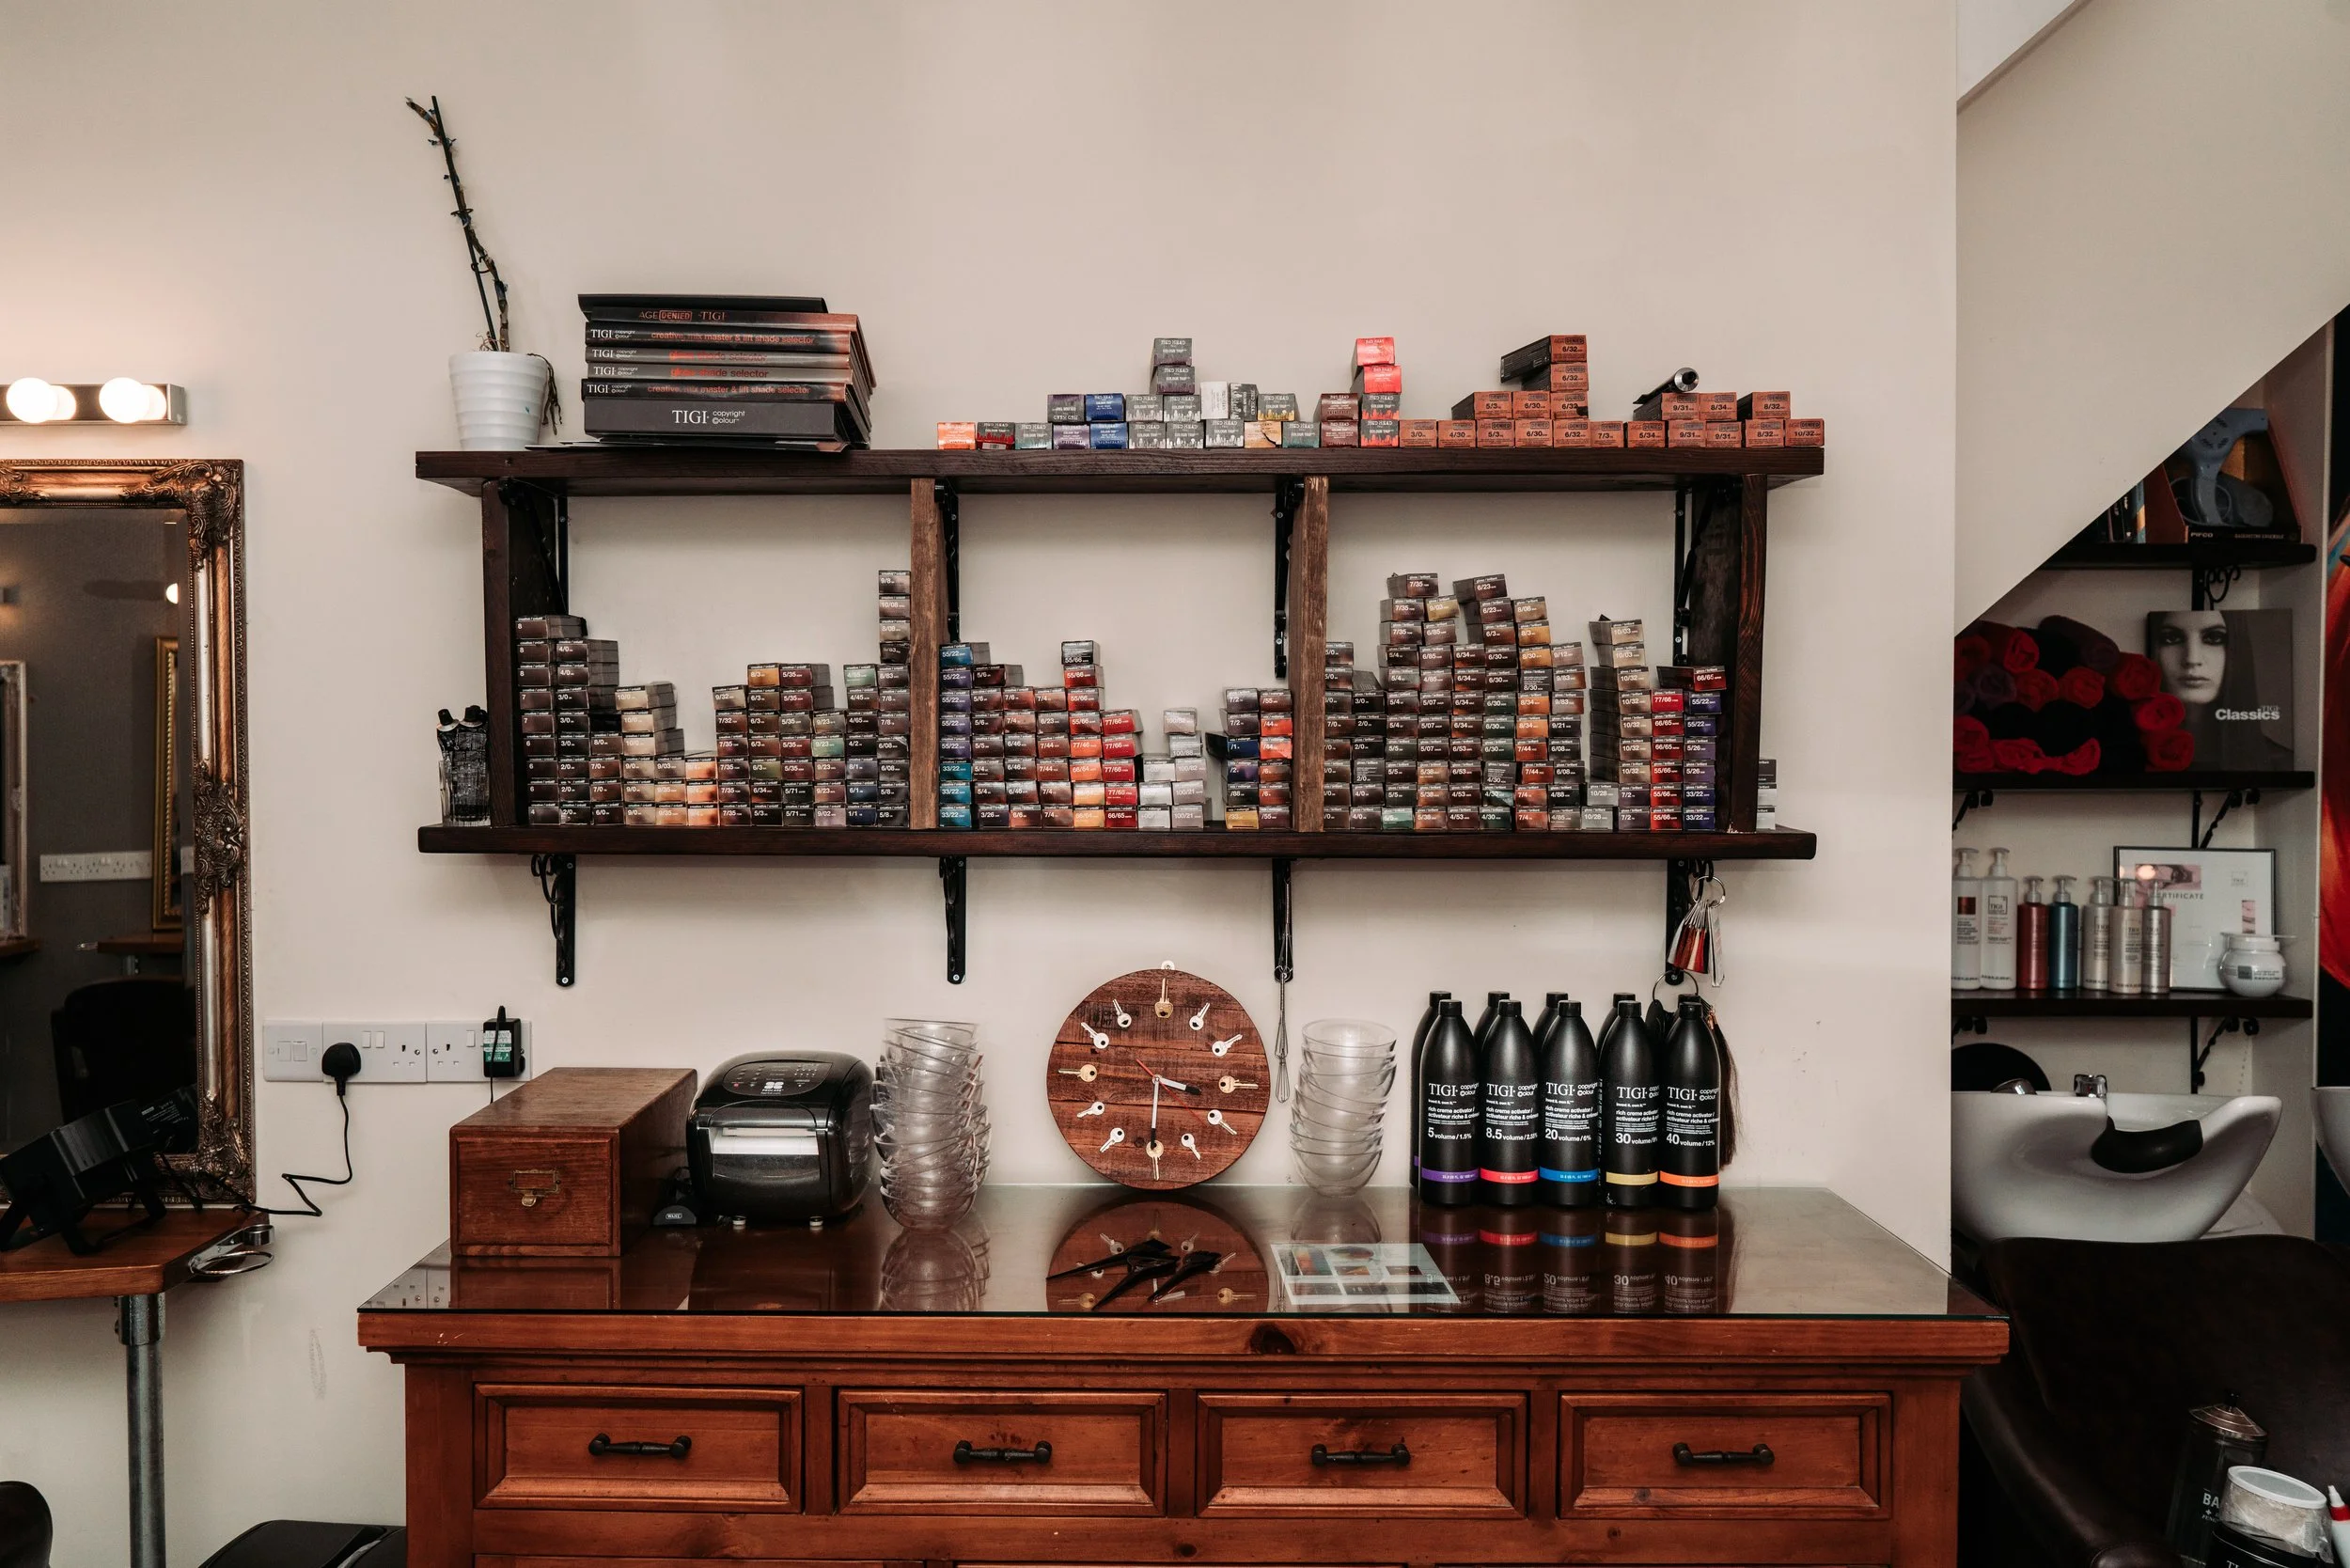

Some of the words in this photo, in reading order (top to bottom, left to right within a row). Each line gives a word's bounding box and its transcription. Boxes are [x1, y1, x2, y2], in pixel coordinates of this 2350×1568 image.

[661, 311, 691, 321] DENIED
[700, 311, 726, 321] TIGI
[590, 329, 612, 338] TIGI
[743, 334, 753, 342] lift
[755, 335, 779, 343] shade
[781, 336, 815, 344] selector
[592, 349, 614, 358] TIGI
[594, 367, 616, 376] TIGI
[699, 368, 728, 378] shade
[730, 368, 769, 378] selector
[588, 384, 609, 394] TIGI
[700, 385, 728, 394] master
[739, 385, 749, 394] lift
[751, 385, 776, 394] shade
[777, 386, 811, 395] selector
[672, 410, 707, 424] TIGI
[713, 410, 745, 418] copyright
[2215, 709, 2280, 721] Classics
[1429, 1083, 1456, 1096] TIGI
[1487, 1083, 1513, 1097] TIGI
[1545, 1082, 1574, 1096] TIGI
[1617, 1086, 1646, 1099] TIGI
[1668, 1087, 1695, 1100] TIGI
[1428, 1127, 1434, 1137] 5
[1486, 1127, 1502, 1139] 8.5
[1545, 1128, 1559, 1140] 20
[1616, 1133, 1632, 1144] 30
[1667, 1133, 1680, 1145] 40
